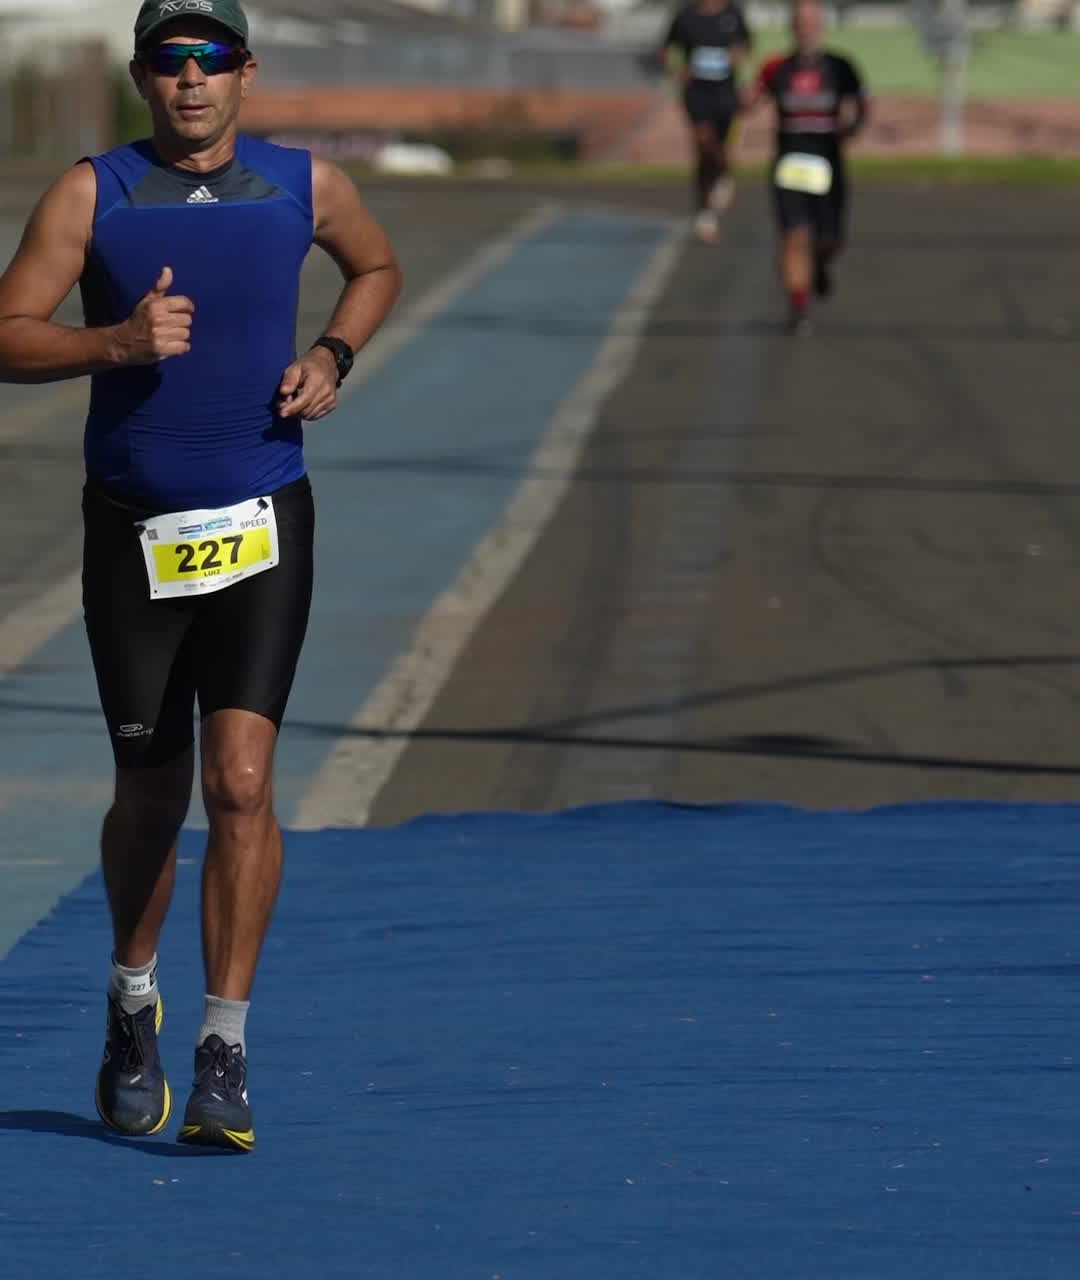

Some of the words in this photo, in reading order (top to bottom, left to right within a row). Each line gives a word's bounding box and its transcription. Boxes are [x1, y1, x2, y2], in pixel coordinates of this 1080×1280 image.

[240, 518, 268, 529] SPEED
[175, 534, 244, 573] 227
[130, 982, 146, 991] 227
